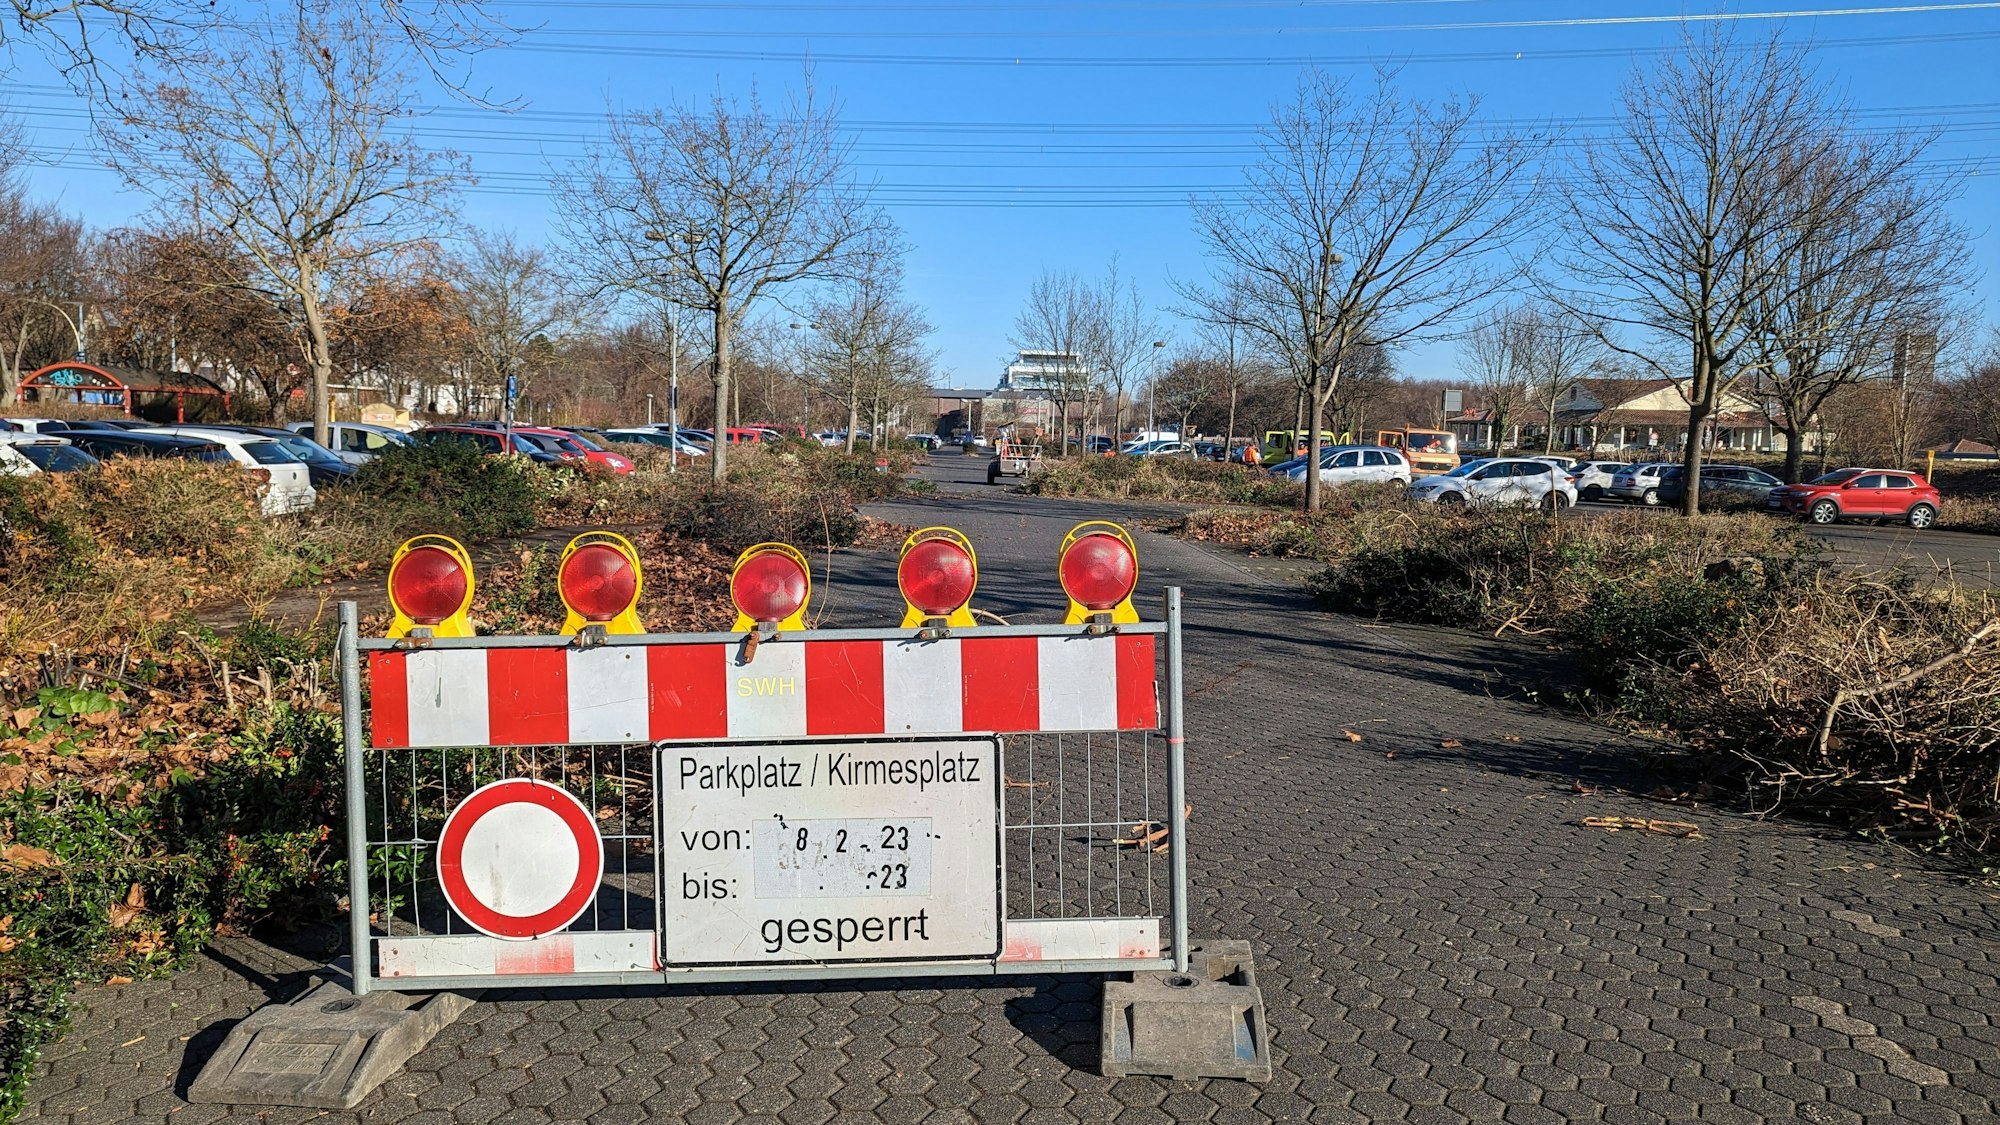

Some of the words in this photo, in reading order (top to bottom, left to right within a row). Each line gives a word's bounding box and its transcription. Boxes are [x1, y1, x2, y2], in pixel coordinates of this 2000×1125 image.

[737, 676, 795, 697] SWH
[680, 754, 803, 798] Parkplatz
[810, 753, 819, 787] /
[828, 749, 981, 793] Kirmesplatz
[680, 828, 751, 851] von:
[682, 871, 738, 900] bis:
[760, 907, 930, 954] gesperrt
